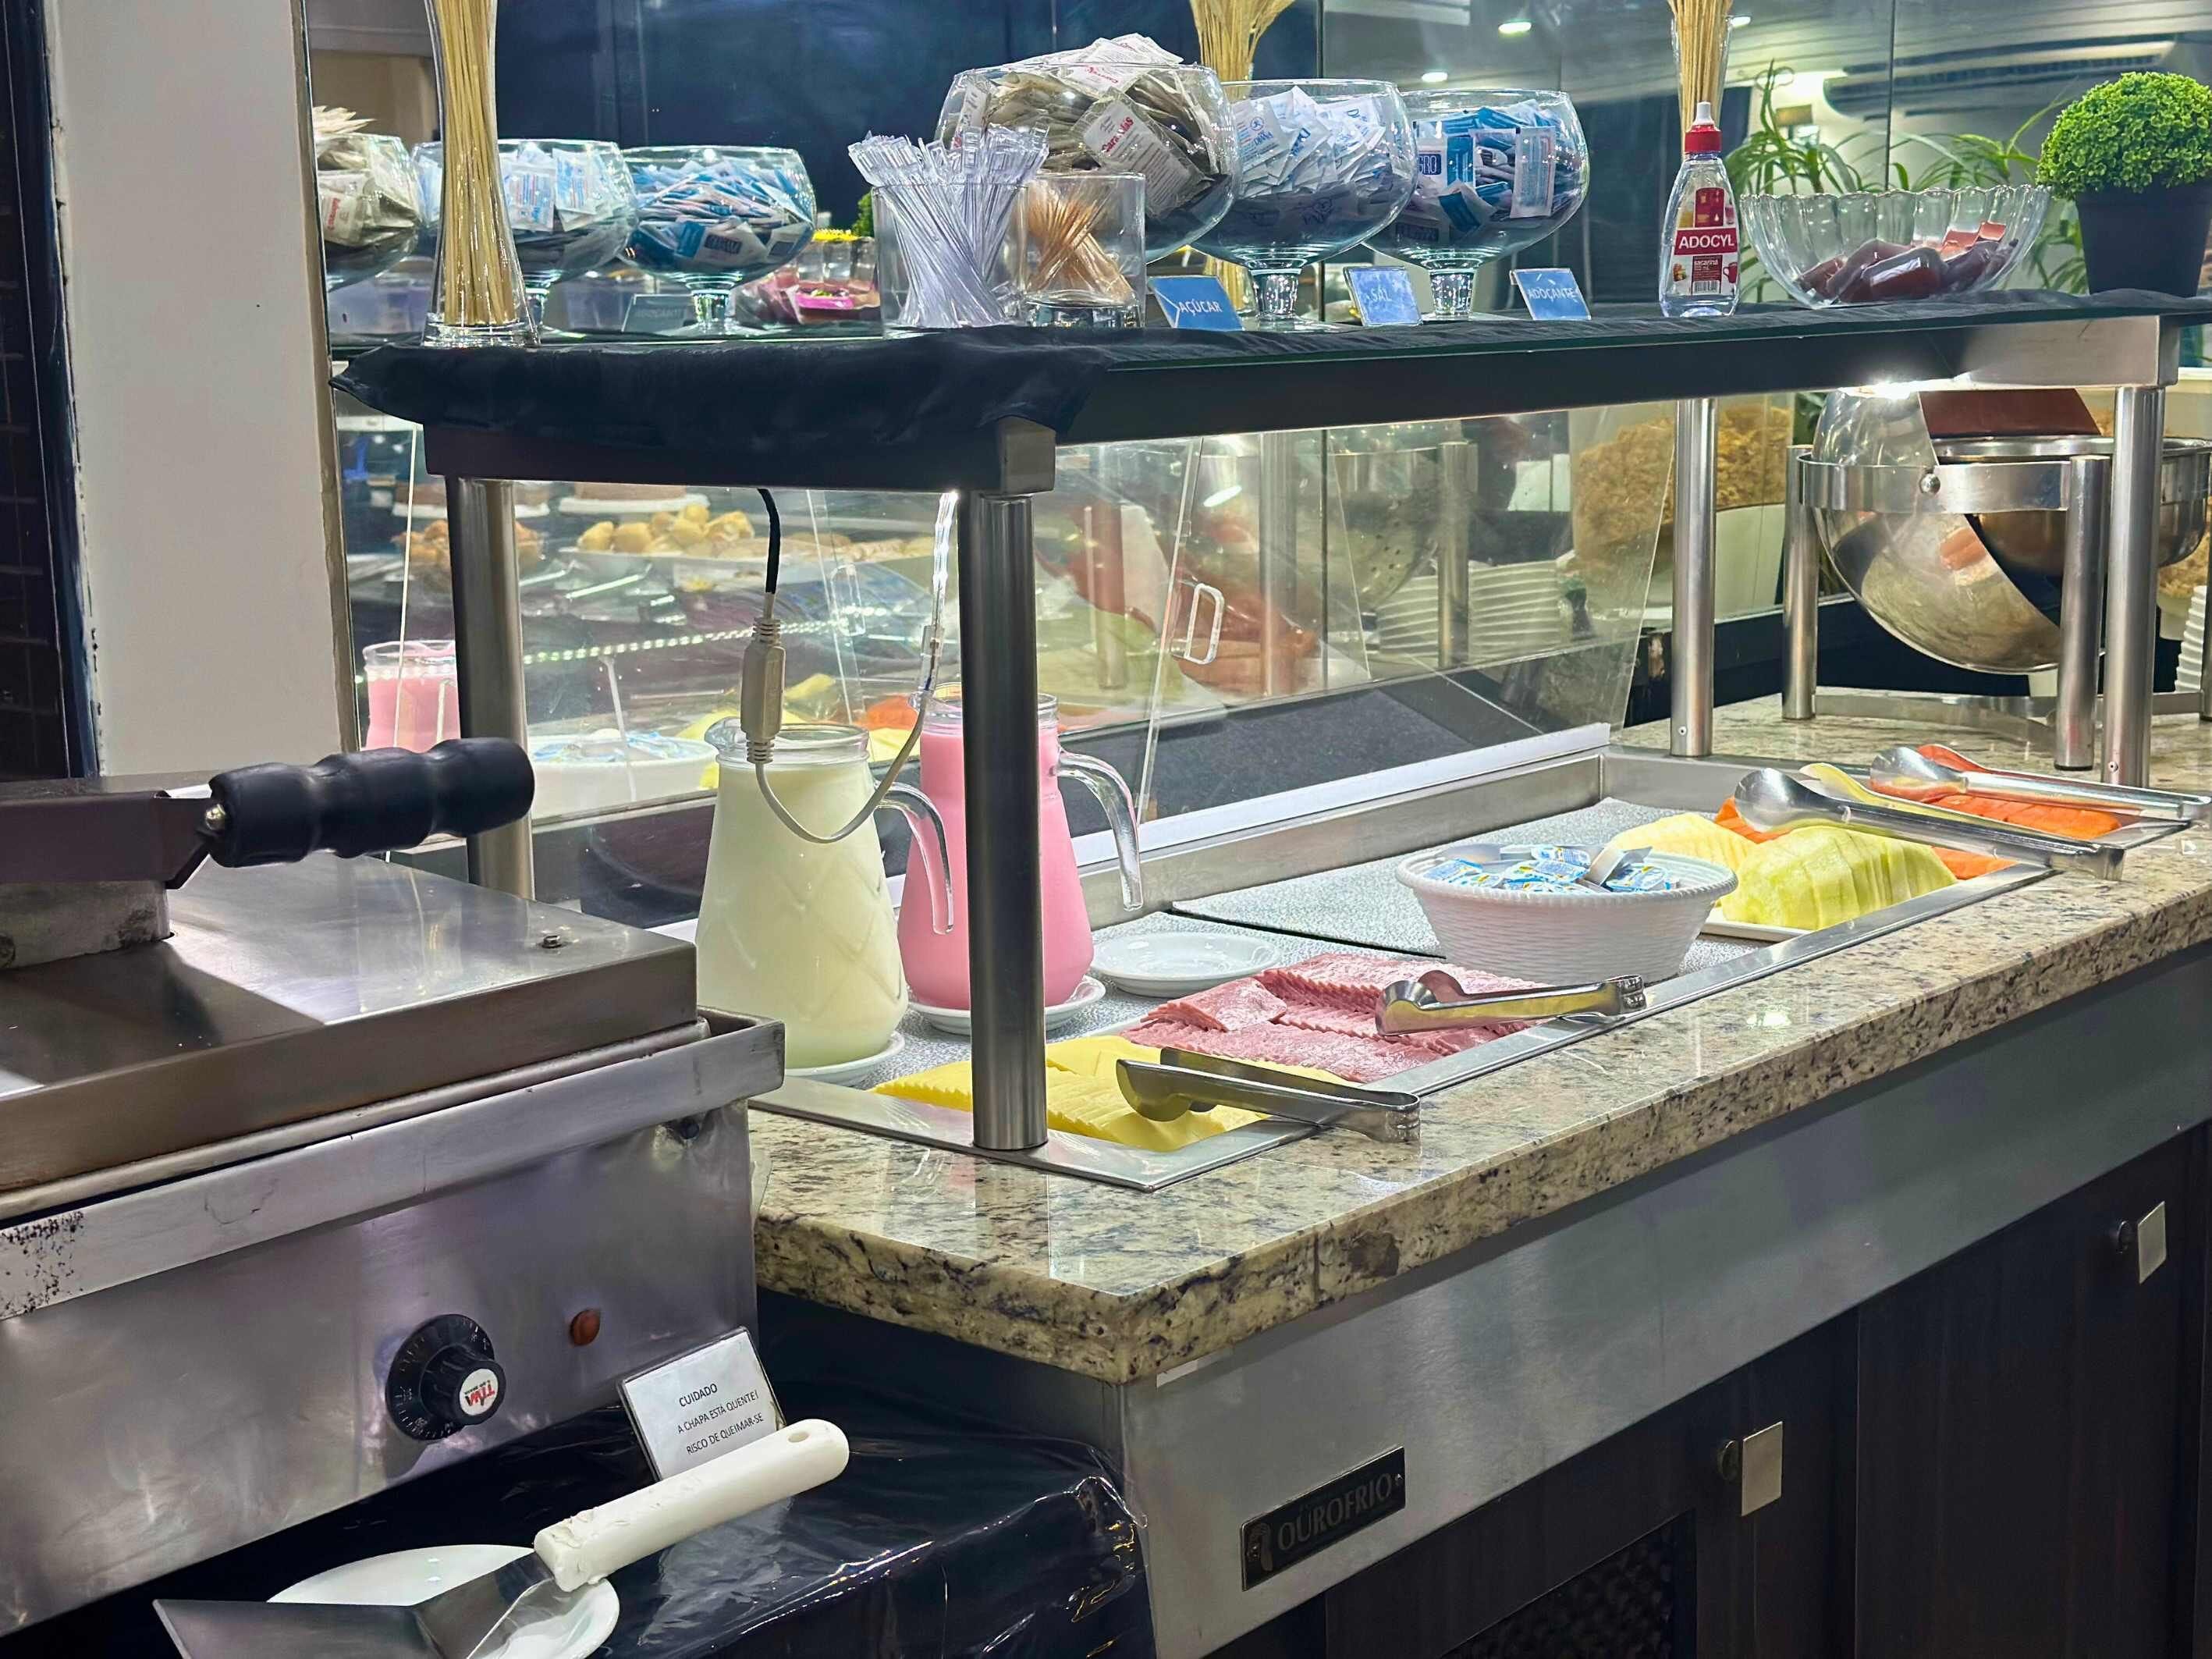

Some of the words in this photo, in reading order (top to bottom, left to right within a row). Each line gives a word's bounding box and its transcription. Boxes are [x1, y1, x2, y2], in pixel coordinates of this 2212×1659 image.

[1678, 234, 1734, 250] ADOCYL
[1527, 287, 1575, 303] ADOÇANTE
[1179, 298, 1222, 316] AÇÚCAR
[679, 1383, 718, 1407] CUIDADO
[677, 1424, 683, 1434] A
[683, 1413, 710, 1430] CHAPA
[686, 1438, 708, 1455] RISCO
[708, 1432, 720, 1444] DE
[720, 1412, 765, 1440] QUEIMAR-SE
[1277, 1472, 1393, 1551] OUROFRIO
